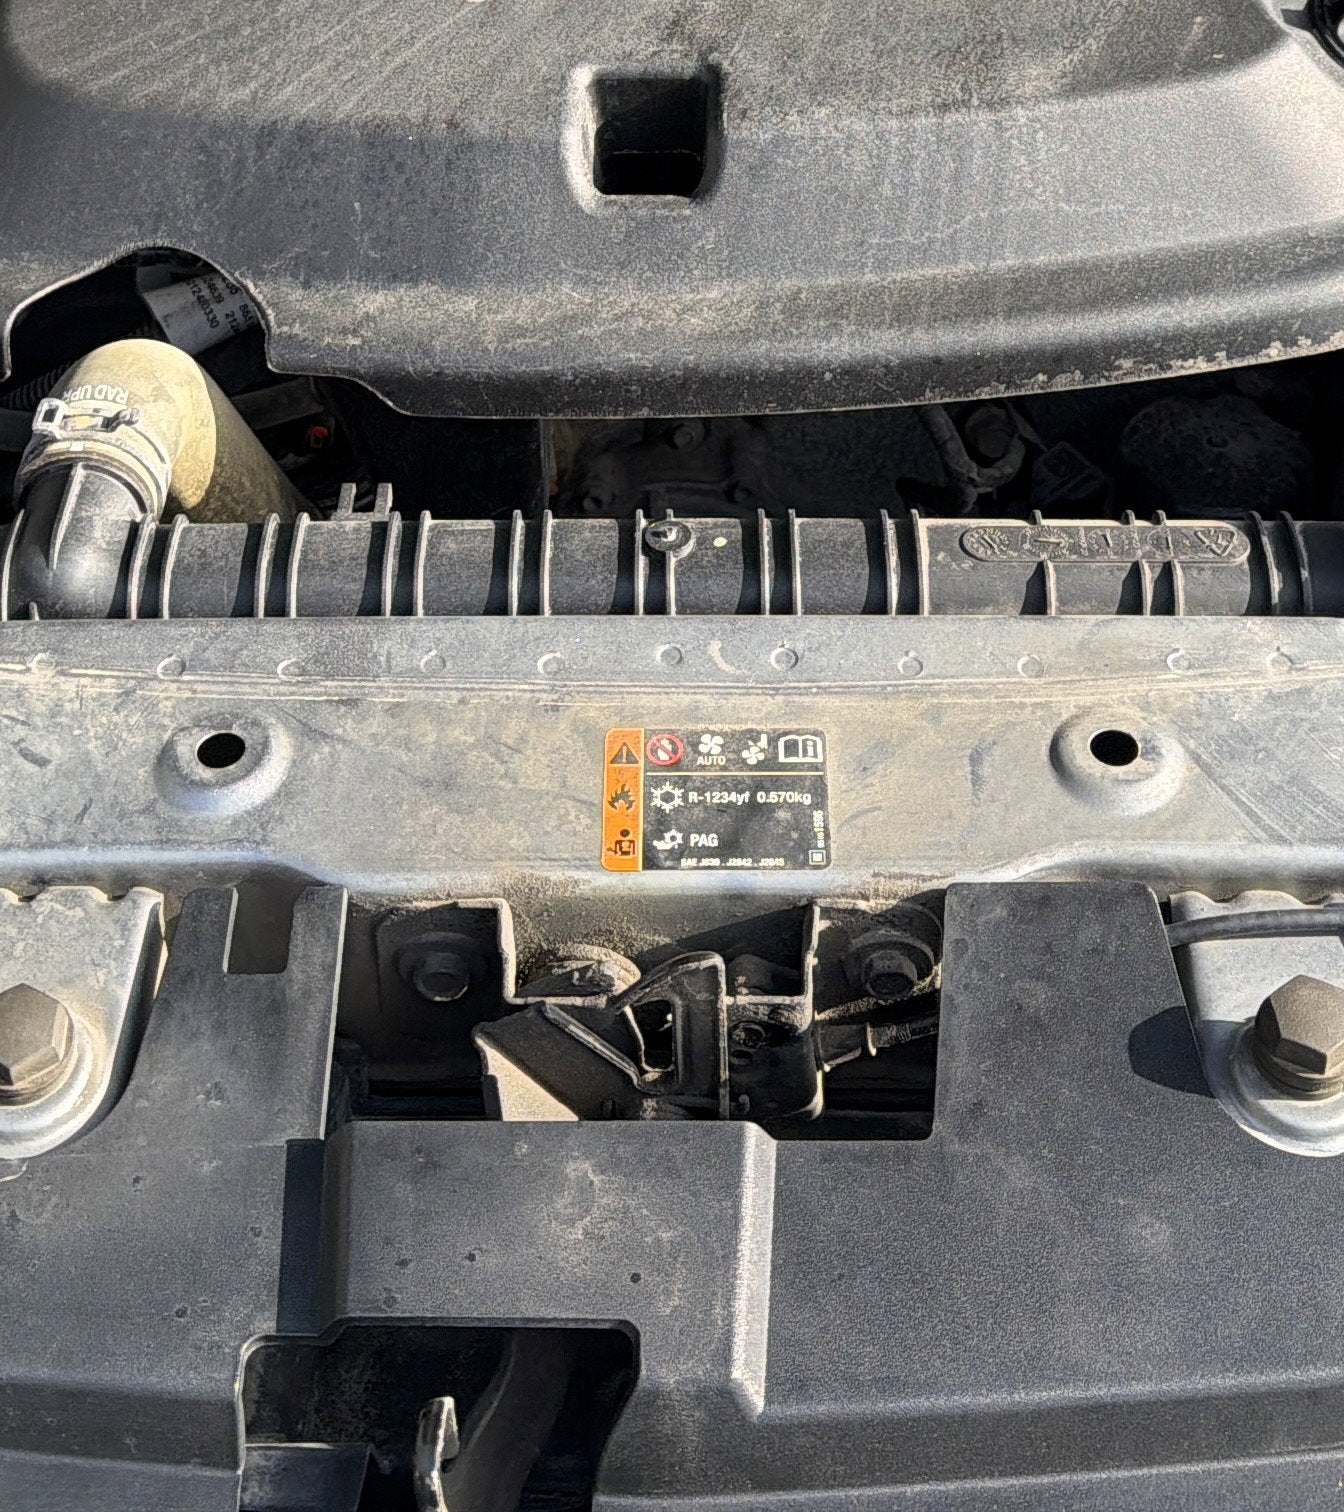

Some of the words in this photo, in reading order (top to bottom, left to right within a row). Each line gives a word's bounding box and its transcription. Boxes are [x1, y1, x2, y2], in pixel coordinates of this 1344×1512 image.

[94, 384, 129, 405] RAD
[696, 755, 727, 766] AUTO
[688, 791, 750, 805] R-1234yf
[756, 791, 812, 805] 0.570kg
[689, 833, 719, 848] PAG
[680, 857, 698, 867] SAE
